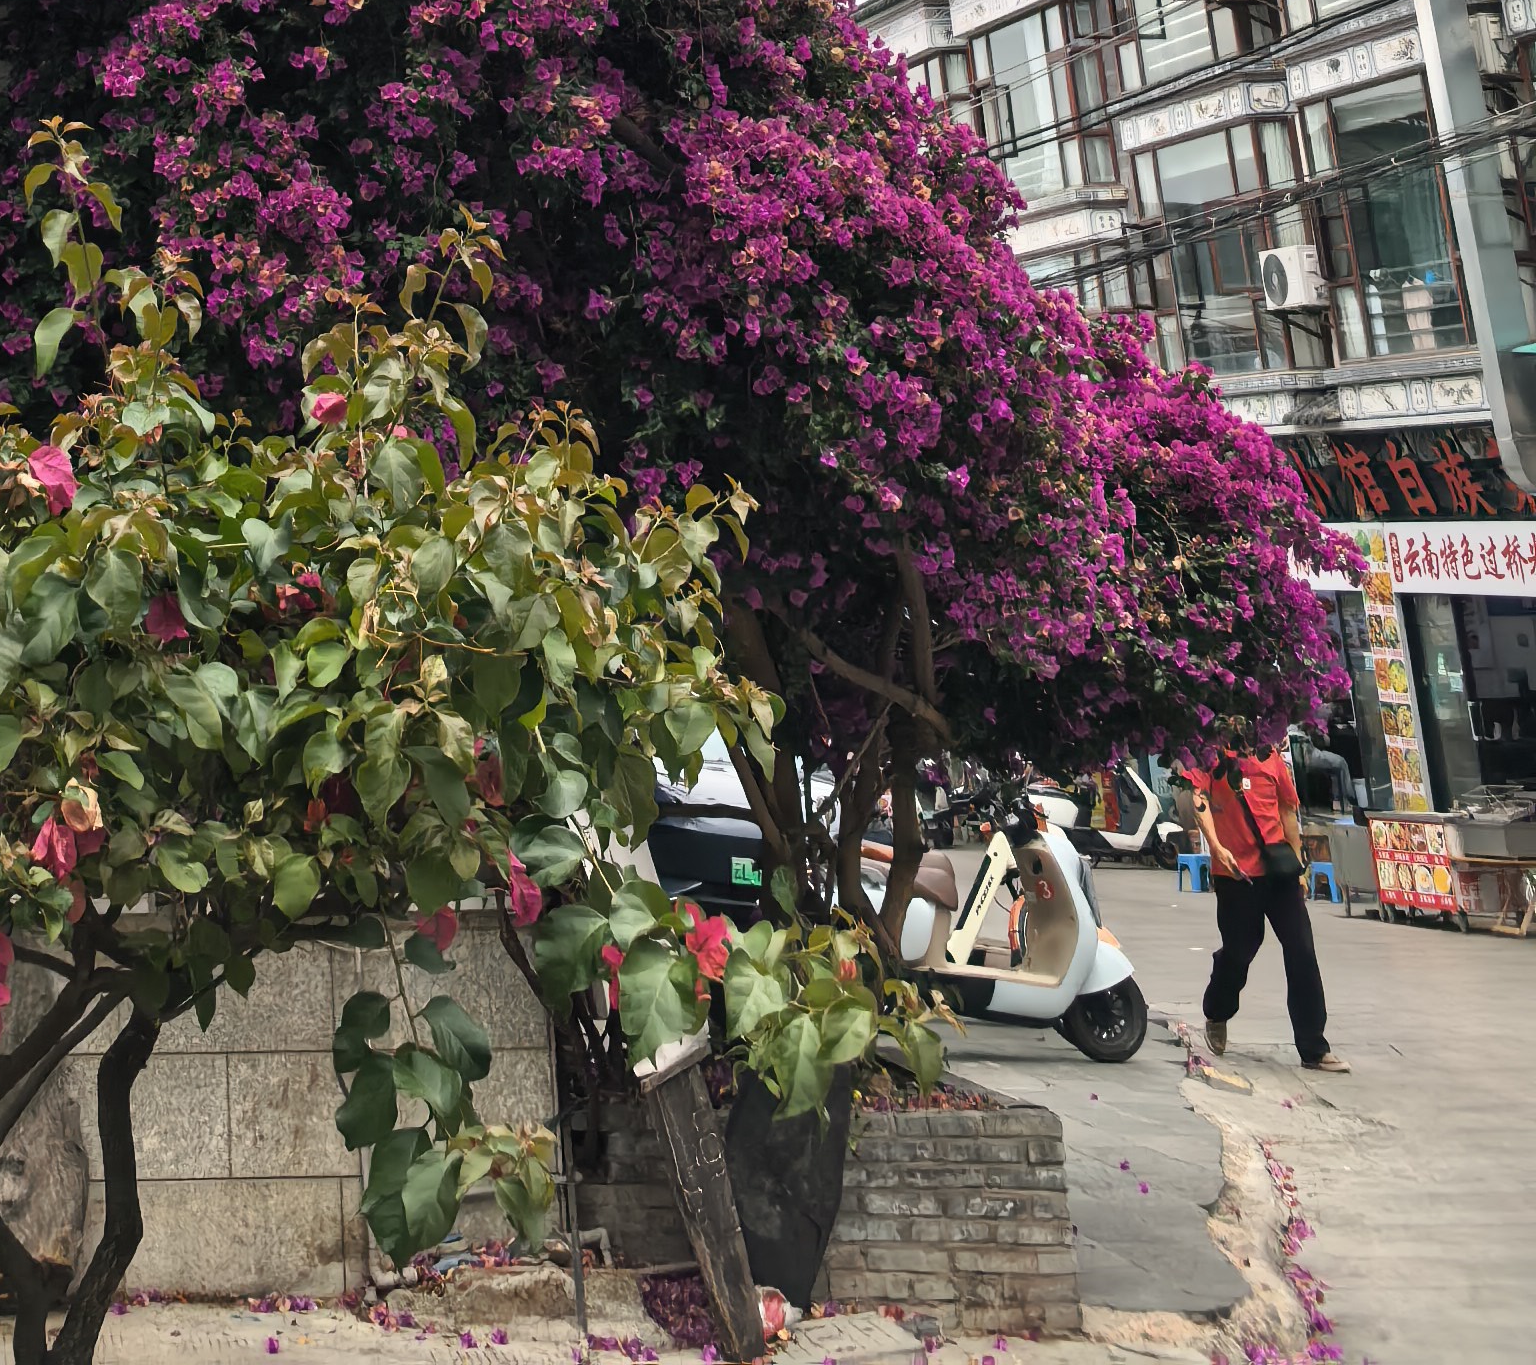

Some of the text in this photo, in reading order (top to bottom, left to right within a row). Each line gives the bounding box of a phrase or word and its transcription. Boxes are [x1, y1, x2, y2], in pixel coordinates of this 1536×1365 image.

[1289, 437, 1536, 517] 小馆白族
[1038, 880, 1051, 899] 3
